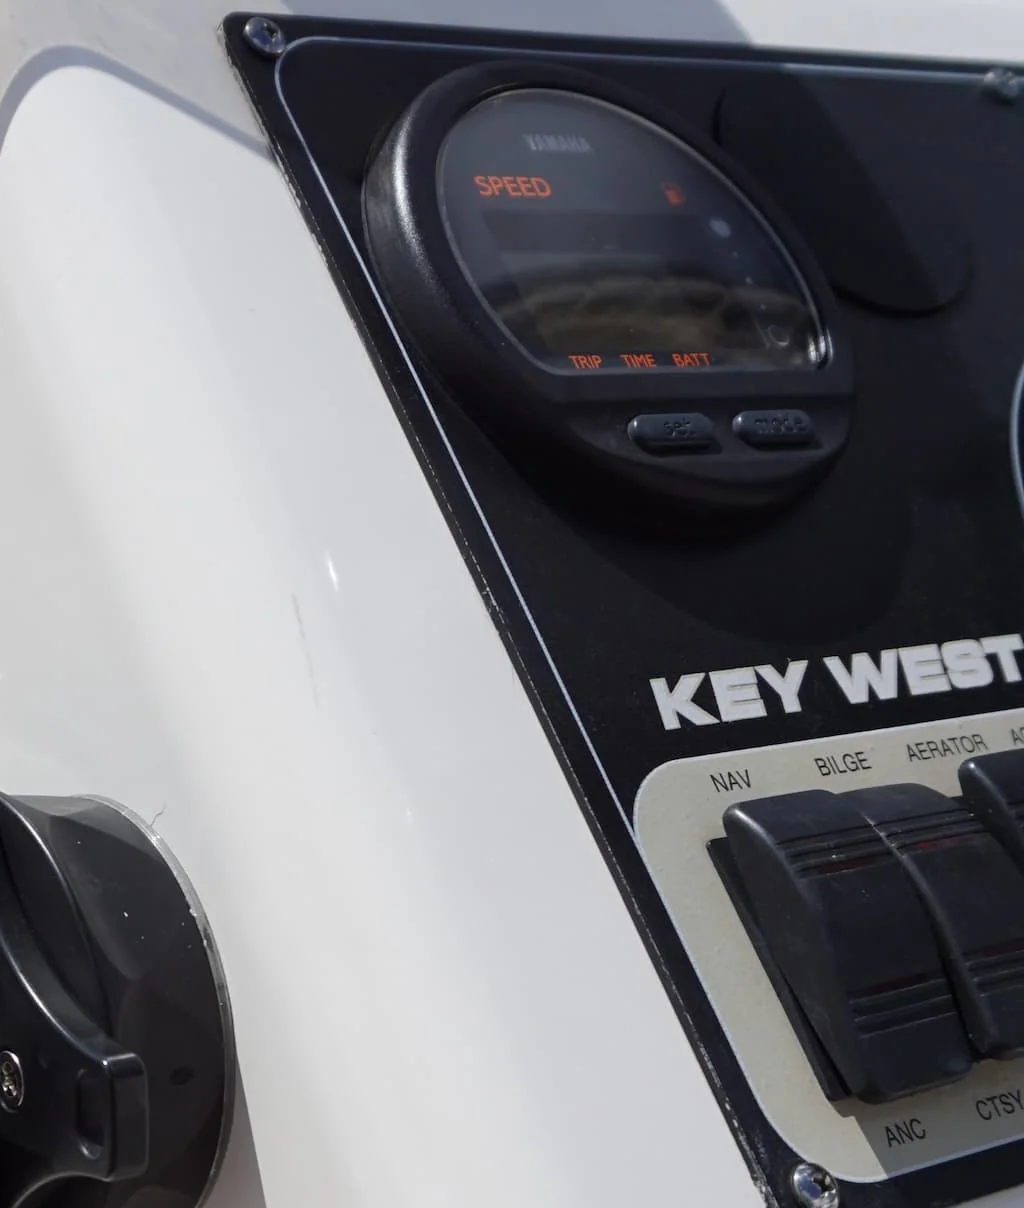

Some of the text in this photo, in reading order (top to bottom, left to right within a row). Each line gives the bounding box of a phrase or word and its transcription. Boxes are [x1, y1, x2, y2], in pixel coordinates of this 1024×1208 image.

[474, 175, 553, 198] SPEED
[569, 352, 710, 370] TRIP TIME BATT
[649, 633, 1024, 731] KEY WEST
[906, 733, 989, 762] AERATOR
[814, 751, 872, 777] BILGE
[710, 768, 753, 793] NAV
[975, 1088, 1024, 1121] CTSY
[884, 1118, 926, 1148] ANC
